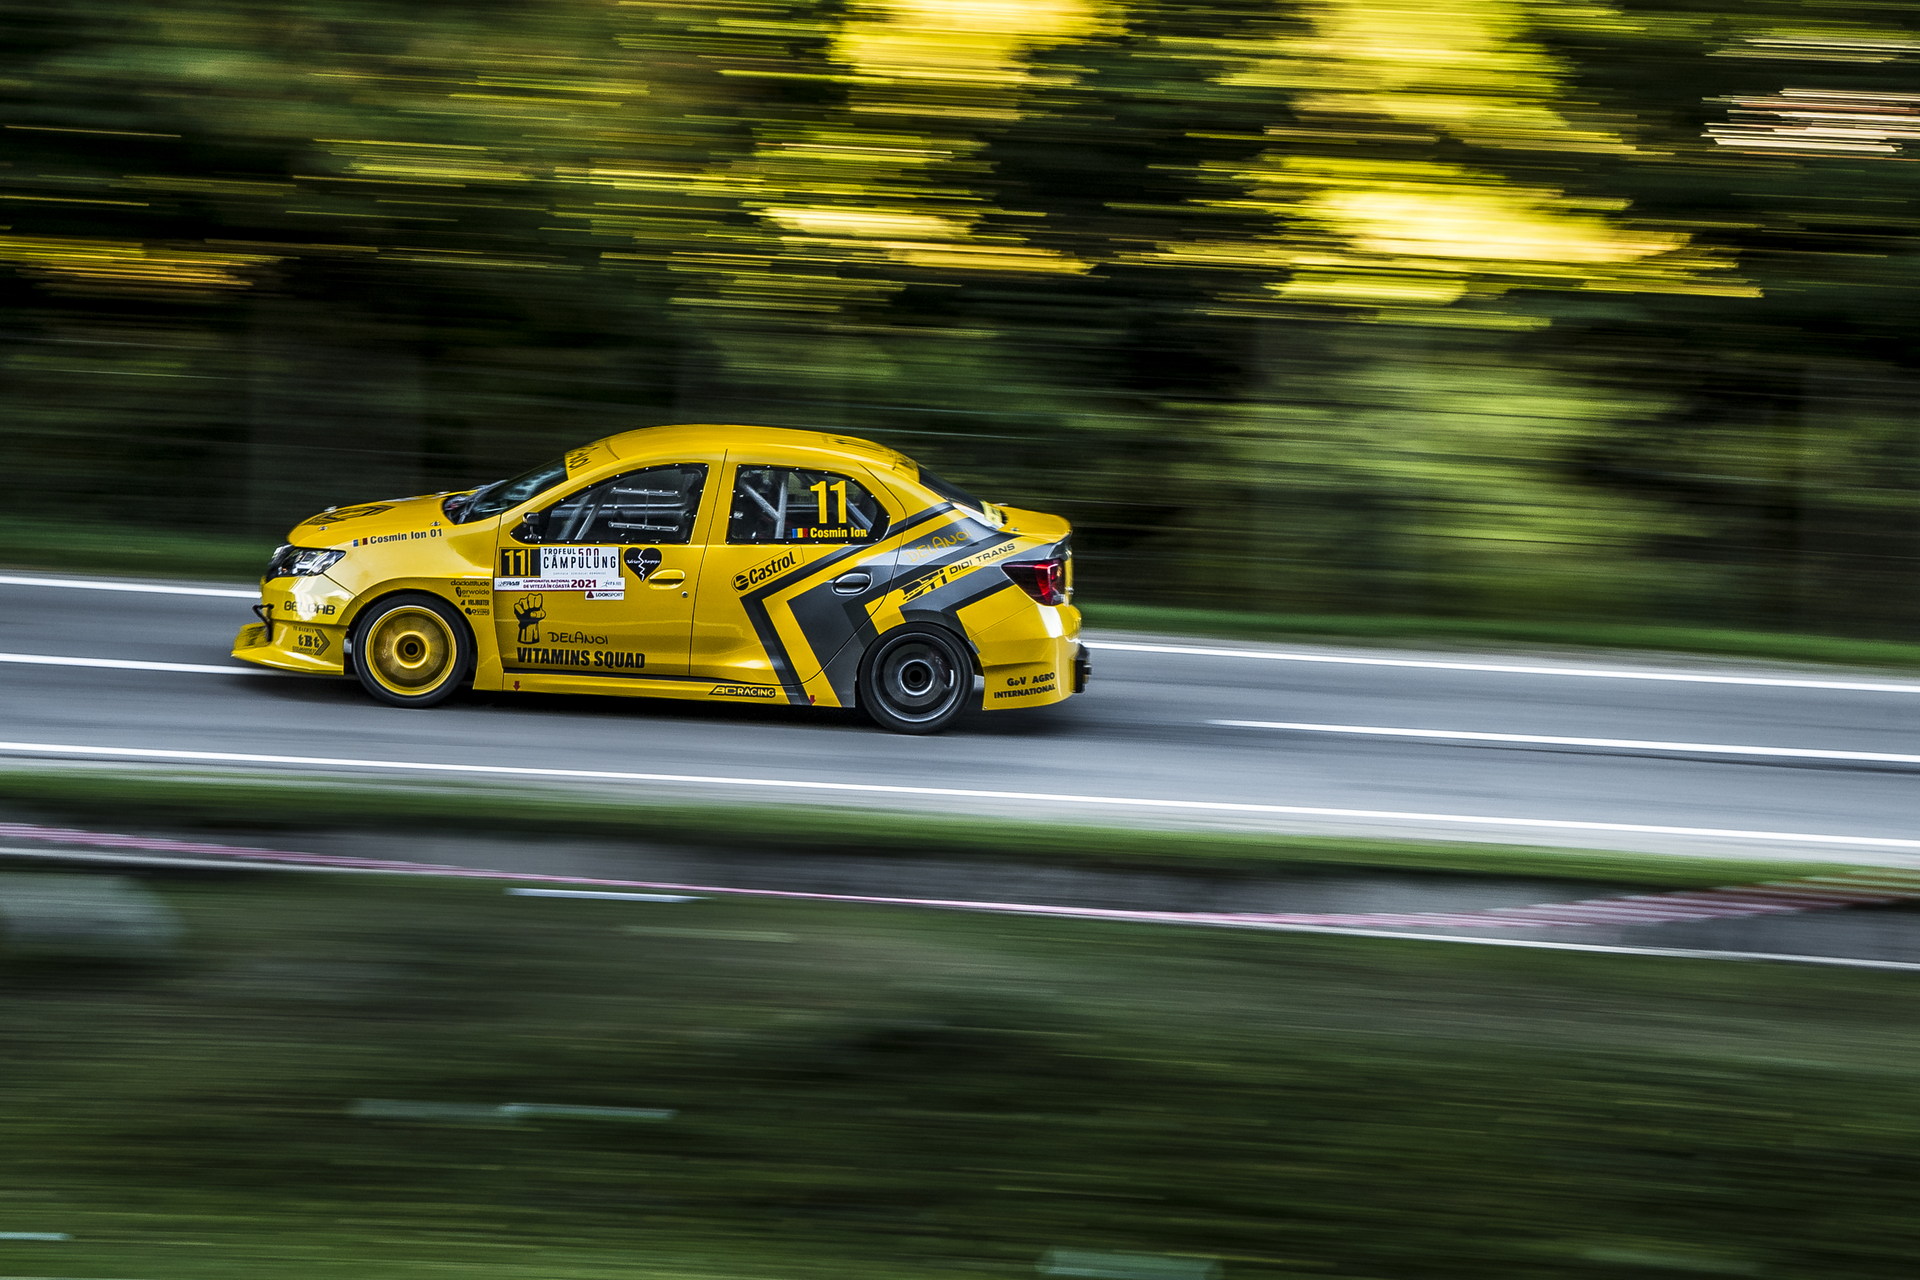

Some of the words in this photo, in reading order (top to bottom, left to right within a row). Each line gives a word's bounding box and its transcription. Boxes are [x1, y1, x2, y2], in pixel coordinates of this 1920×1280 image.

[810, 480, 847, 524] 11
[369, 532, 407, 545] Cosmin
[410, 531, 428, 541] Ion
[430, 528, 443, 539] 01
[809, 527, 848, 539] Cosmin
[850, 527, 868, 538] Ion
[543, 548, 577, 556] TROFEUL
[976, 543, 1016, 563] TRANS
[504, 550, 526, 576] 11
[749, 551, 796, 585] Castrol
[571, 579, 597, 589] 2021
[516, 647, 590, 666] VITAMINS
[594, 650, 646, 669] SQUAD
[1032, 672, 1056, 684] AGRO
[994, 683, 1056, 699] INTERNATIONAL
